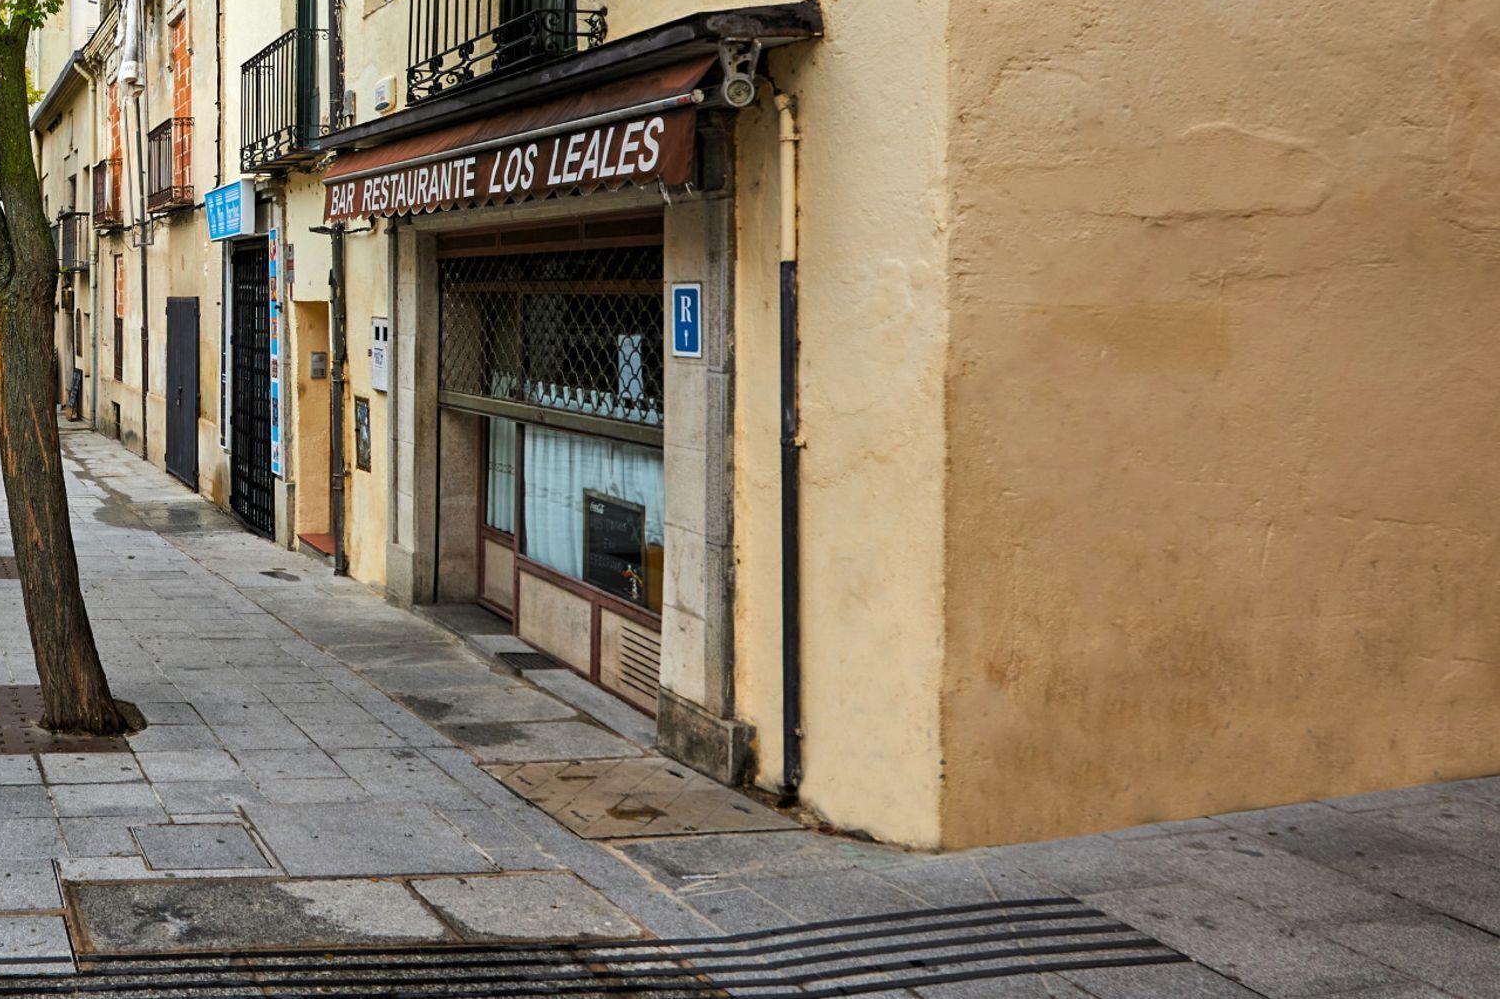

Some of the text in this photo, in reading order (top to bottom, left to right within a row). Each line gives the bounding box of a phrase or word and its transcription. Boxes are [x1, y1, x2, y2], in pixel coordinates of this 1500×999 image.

[330, 116, 666, 217] BAR RESTAURANTE LOS LEALES
[680, 295, 693, 323] R
